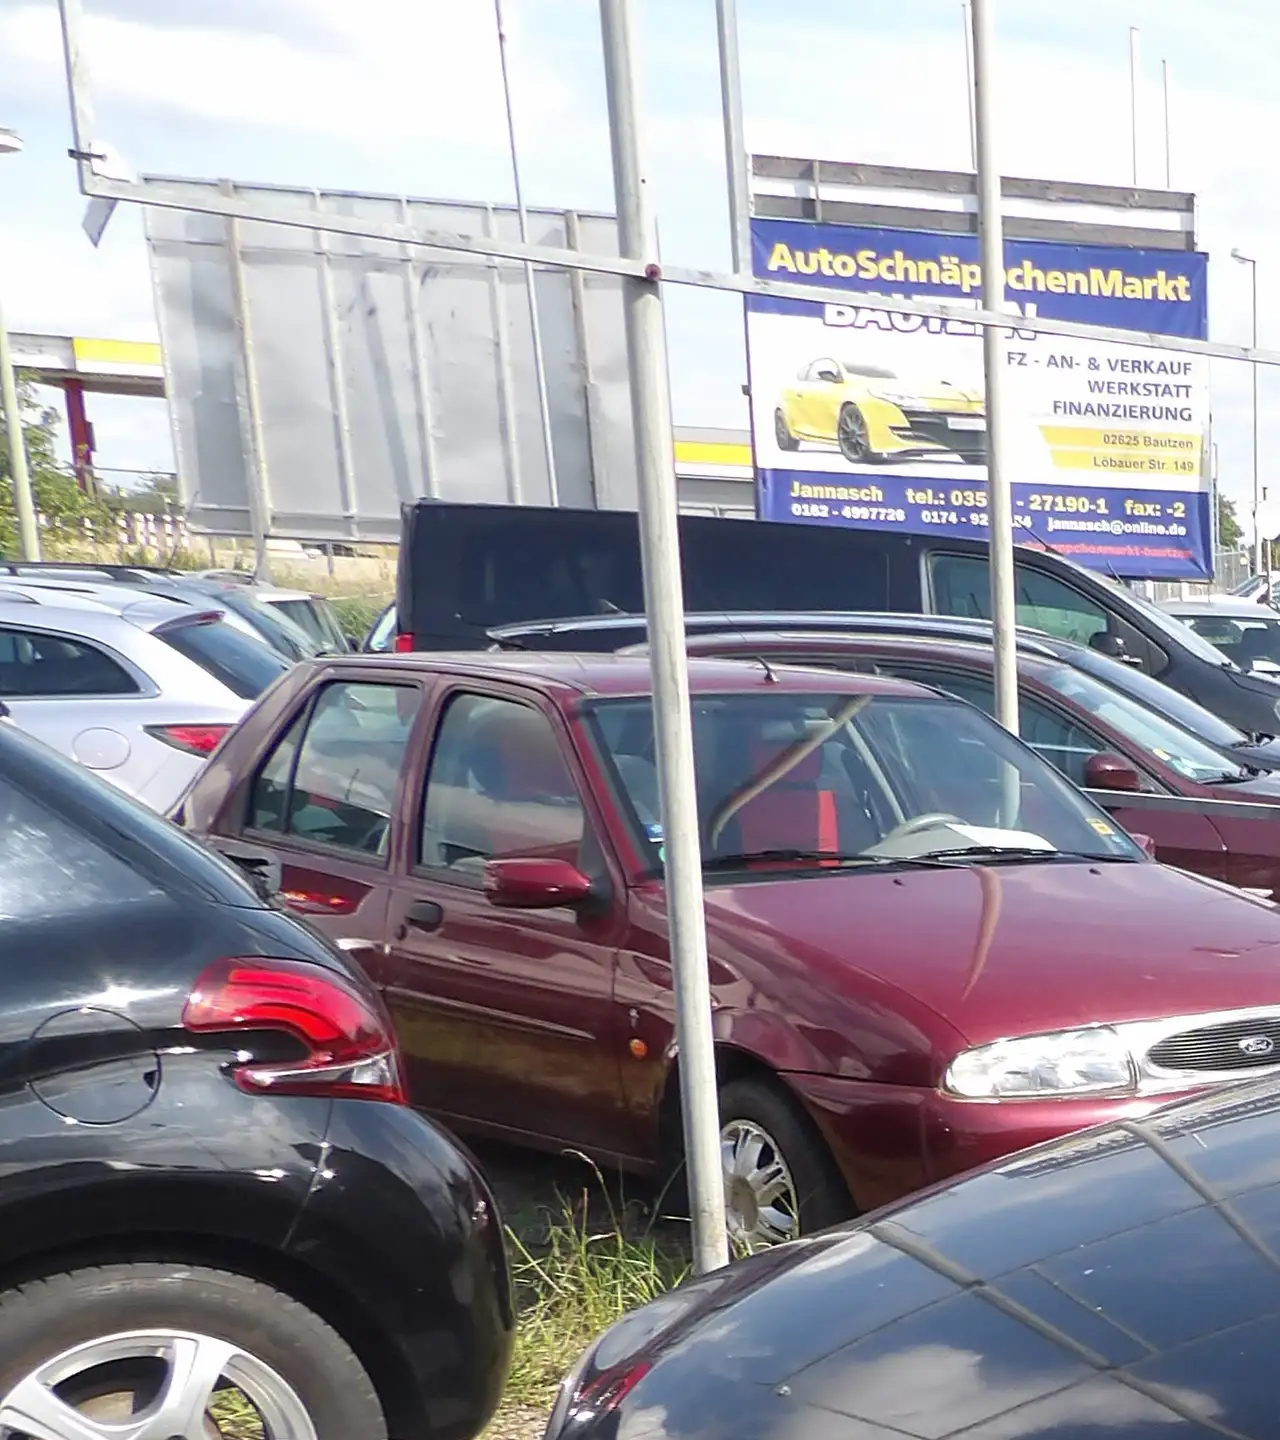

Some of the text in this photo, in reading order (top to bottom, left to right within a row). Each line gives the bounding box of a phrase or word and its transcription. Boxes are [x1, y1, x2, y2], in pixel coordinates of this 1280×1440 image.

[768, 243, 1191, 302] AutoSchnäpchenMarkt
[1007, 352, 1028, 367] FZ
[1047, 354, 1081, 369] AN-
[1088, 356, 1101, 371] &
[1107, 358, 1193, 376] VERKAUF
[1087, 379, 1193, 399] WERKSTATT
[1053, 400, 1193, 422] FINANZIERUNG
[1103, 433, 1194, 449] 02625 Bautzen
[1149, 458, 1169, 472] Str.
[1173, 461, 1194, 472] 149
[790, 480, 884, 502] Jannasch
[905, 488, 946, 505] tel.:
[951, 489, 988, 508] 035
[1029, 494, 1110, 514] 27190-1
[1124, 499, 1162, 518] fax:
[1166, 502, 1187, 518] -2
